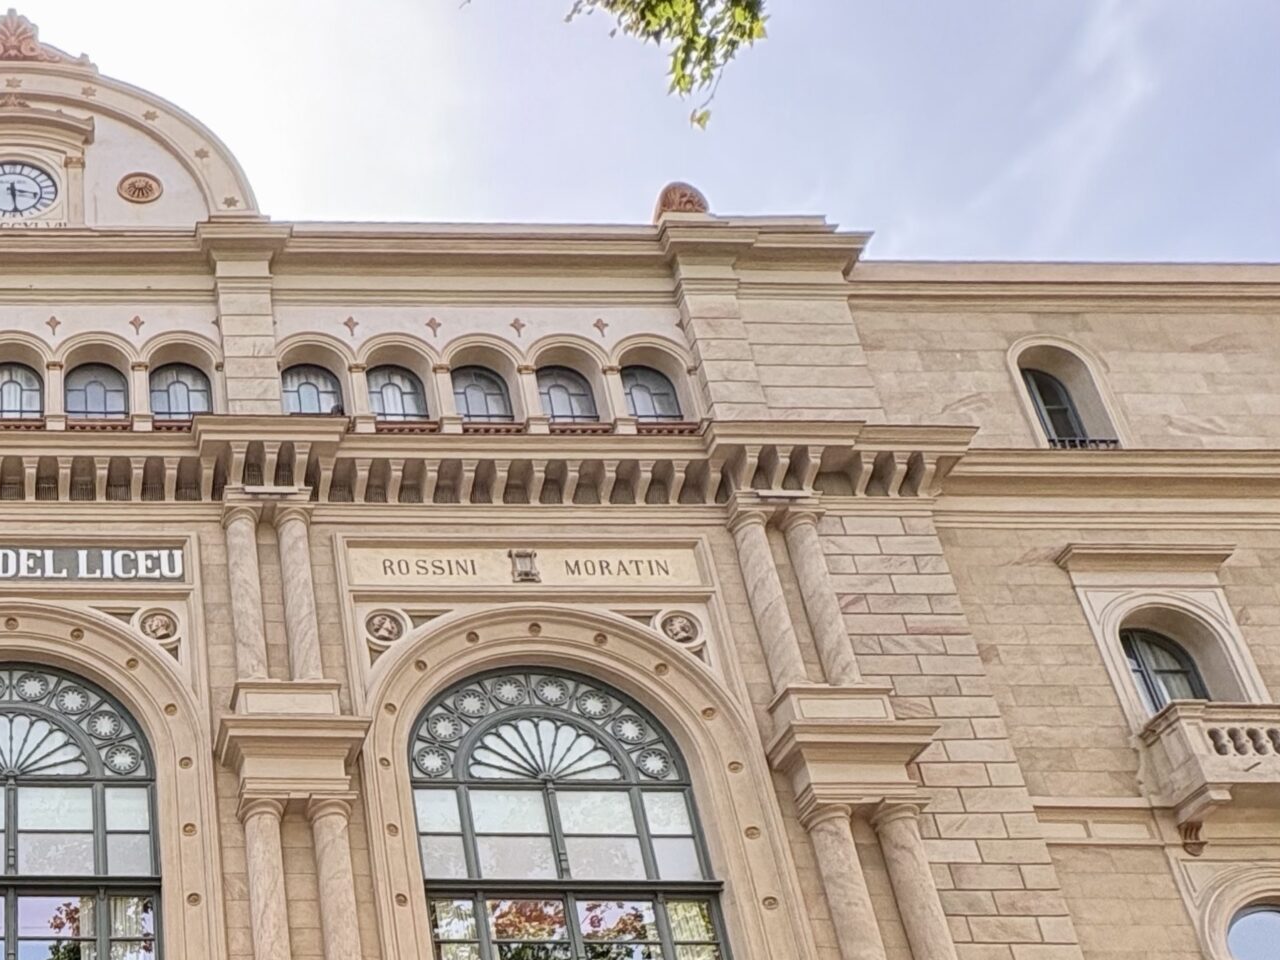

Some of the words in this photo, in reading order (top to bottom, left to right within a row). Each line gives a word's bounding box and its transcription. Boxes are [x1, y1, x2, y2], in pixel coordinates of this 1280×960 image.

[77, 549, 184, 578] LICEU
[382, 559, 478, 576] ROSSINI
[564, 559, 671, 577] MORATIN
